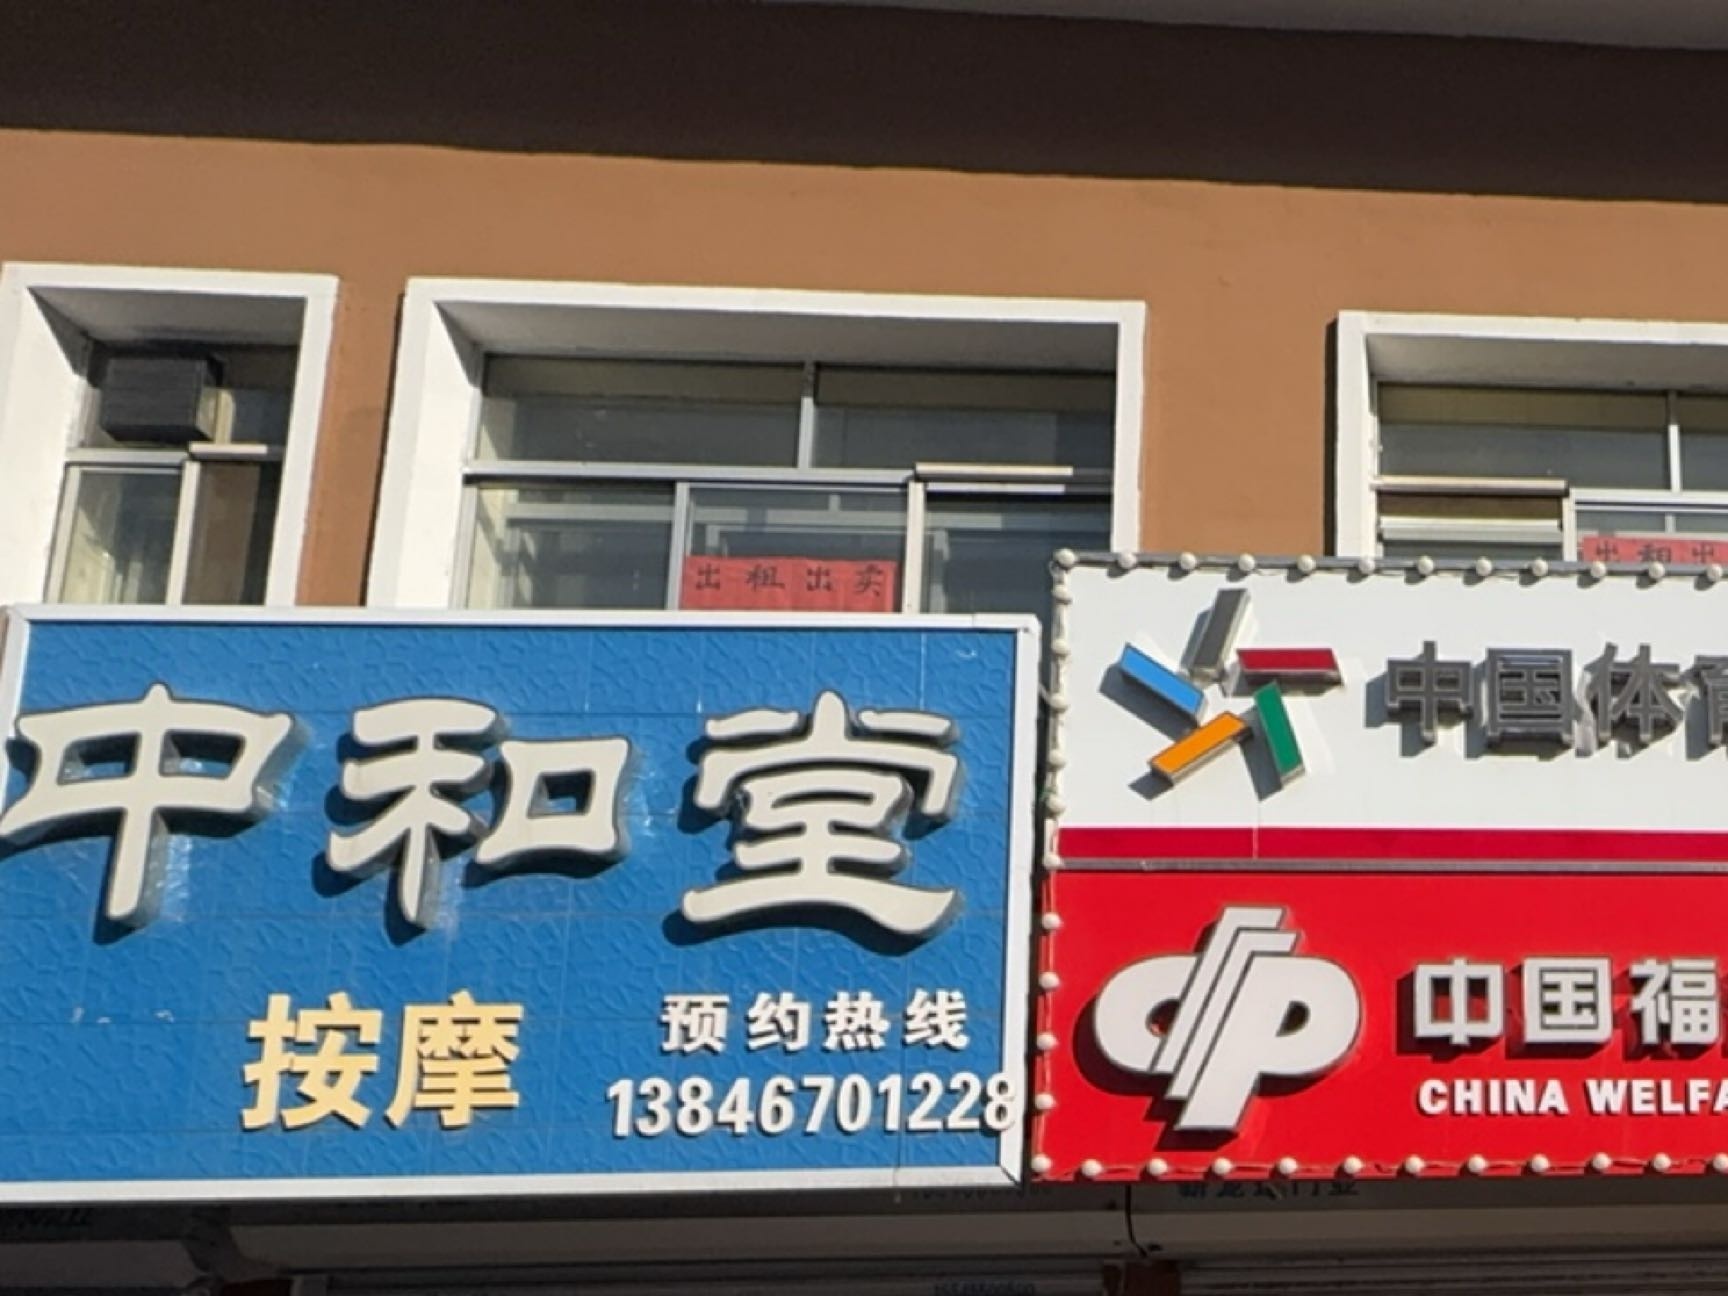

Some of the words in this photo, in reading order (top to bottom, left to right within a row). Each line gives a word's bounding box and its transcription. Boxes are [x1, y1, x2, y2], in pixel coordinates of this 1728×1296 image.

[695, 563, 884, 597] 出租出卖
[0, 684, 960, 936] 中和堂
[660, 991, 970, 1051] 预约热线
[241, 991, 524, 1131] 按摩
[607, 1072, 1018, 1139] 13846701228
[1418, 1077, 1569, 1115] CHINA
